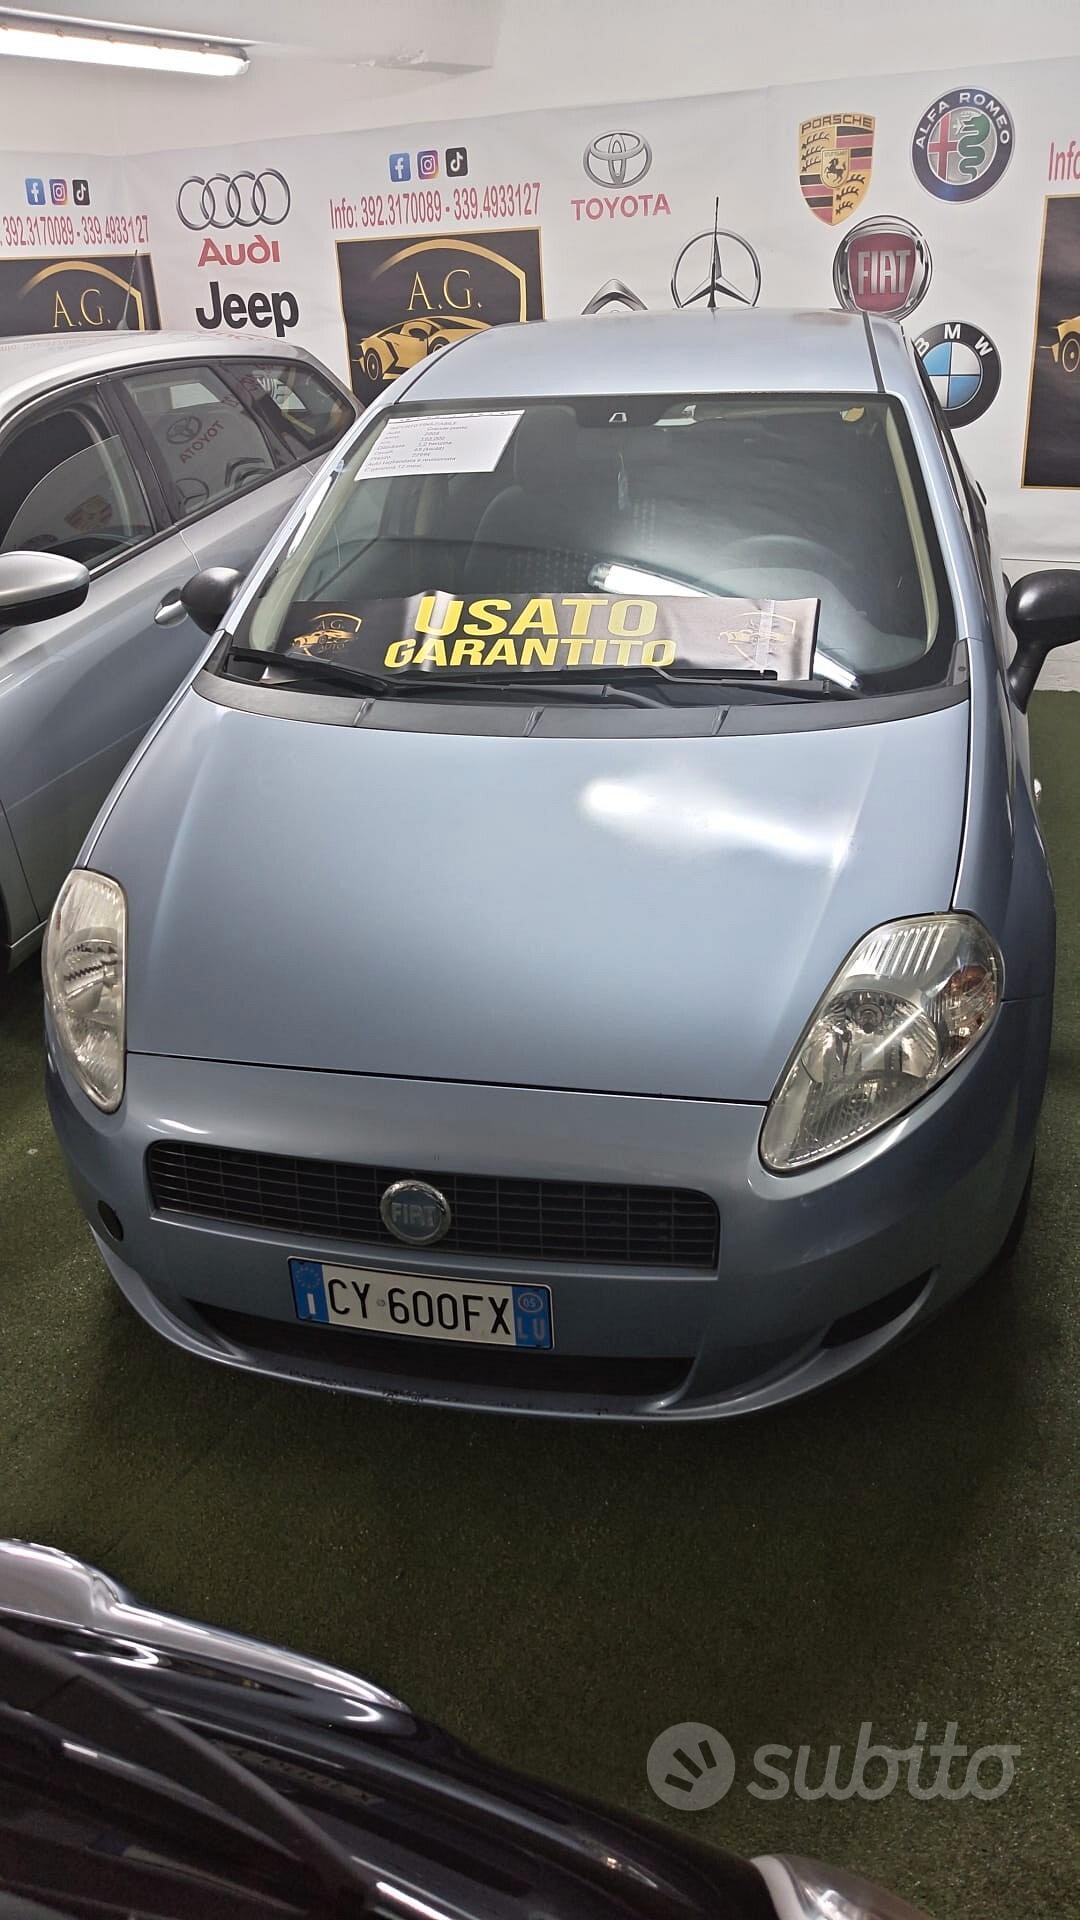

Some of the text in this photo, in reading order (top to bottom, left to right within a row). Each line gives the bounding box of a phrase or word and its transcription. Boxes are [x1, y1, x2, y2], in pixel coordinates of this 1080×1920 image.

[801, 114, 873, 134] PORSCHE
[915, 92, 1010, 149] ALFA ROMEO
[329, 198, 358, 229] Info:
[360, 190, 442, 227] 392.3170089
[453, 182, 541, 219] 339.4933127
[571, 193, 672, 221] TOYOTA
[3, 216, 74, 246] 392.3170089
[81, 215, 150, 244] 339.4933127
[197, 234, 281, 267] Audi
[407, 269, 483, 310] A.G.
[857, 250, 911, 295] FIAT
[53, 289, 111, 329] A.G.
[195, 281, 300, 337] Jeep
[414, 597, 659, 637] USATO
[384, 638, 676, 668] GARANTITO
[391, 1202, 437, 1226] FIAT
[306, 1278, 511, 1335] I CY 600FX
[516, 1316, 545, 1341] LU
